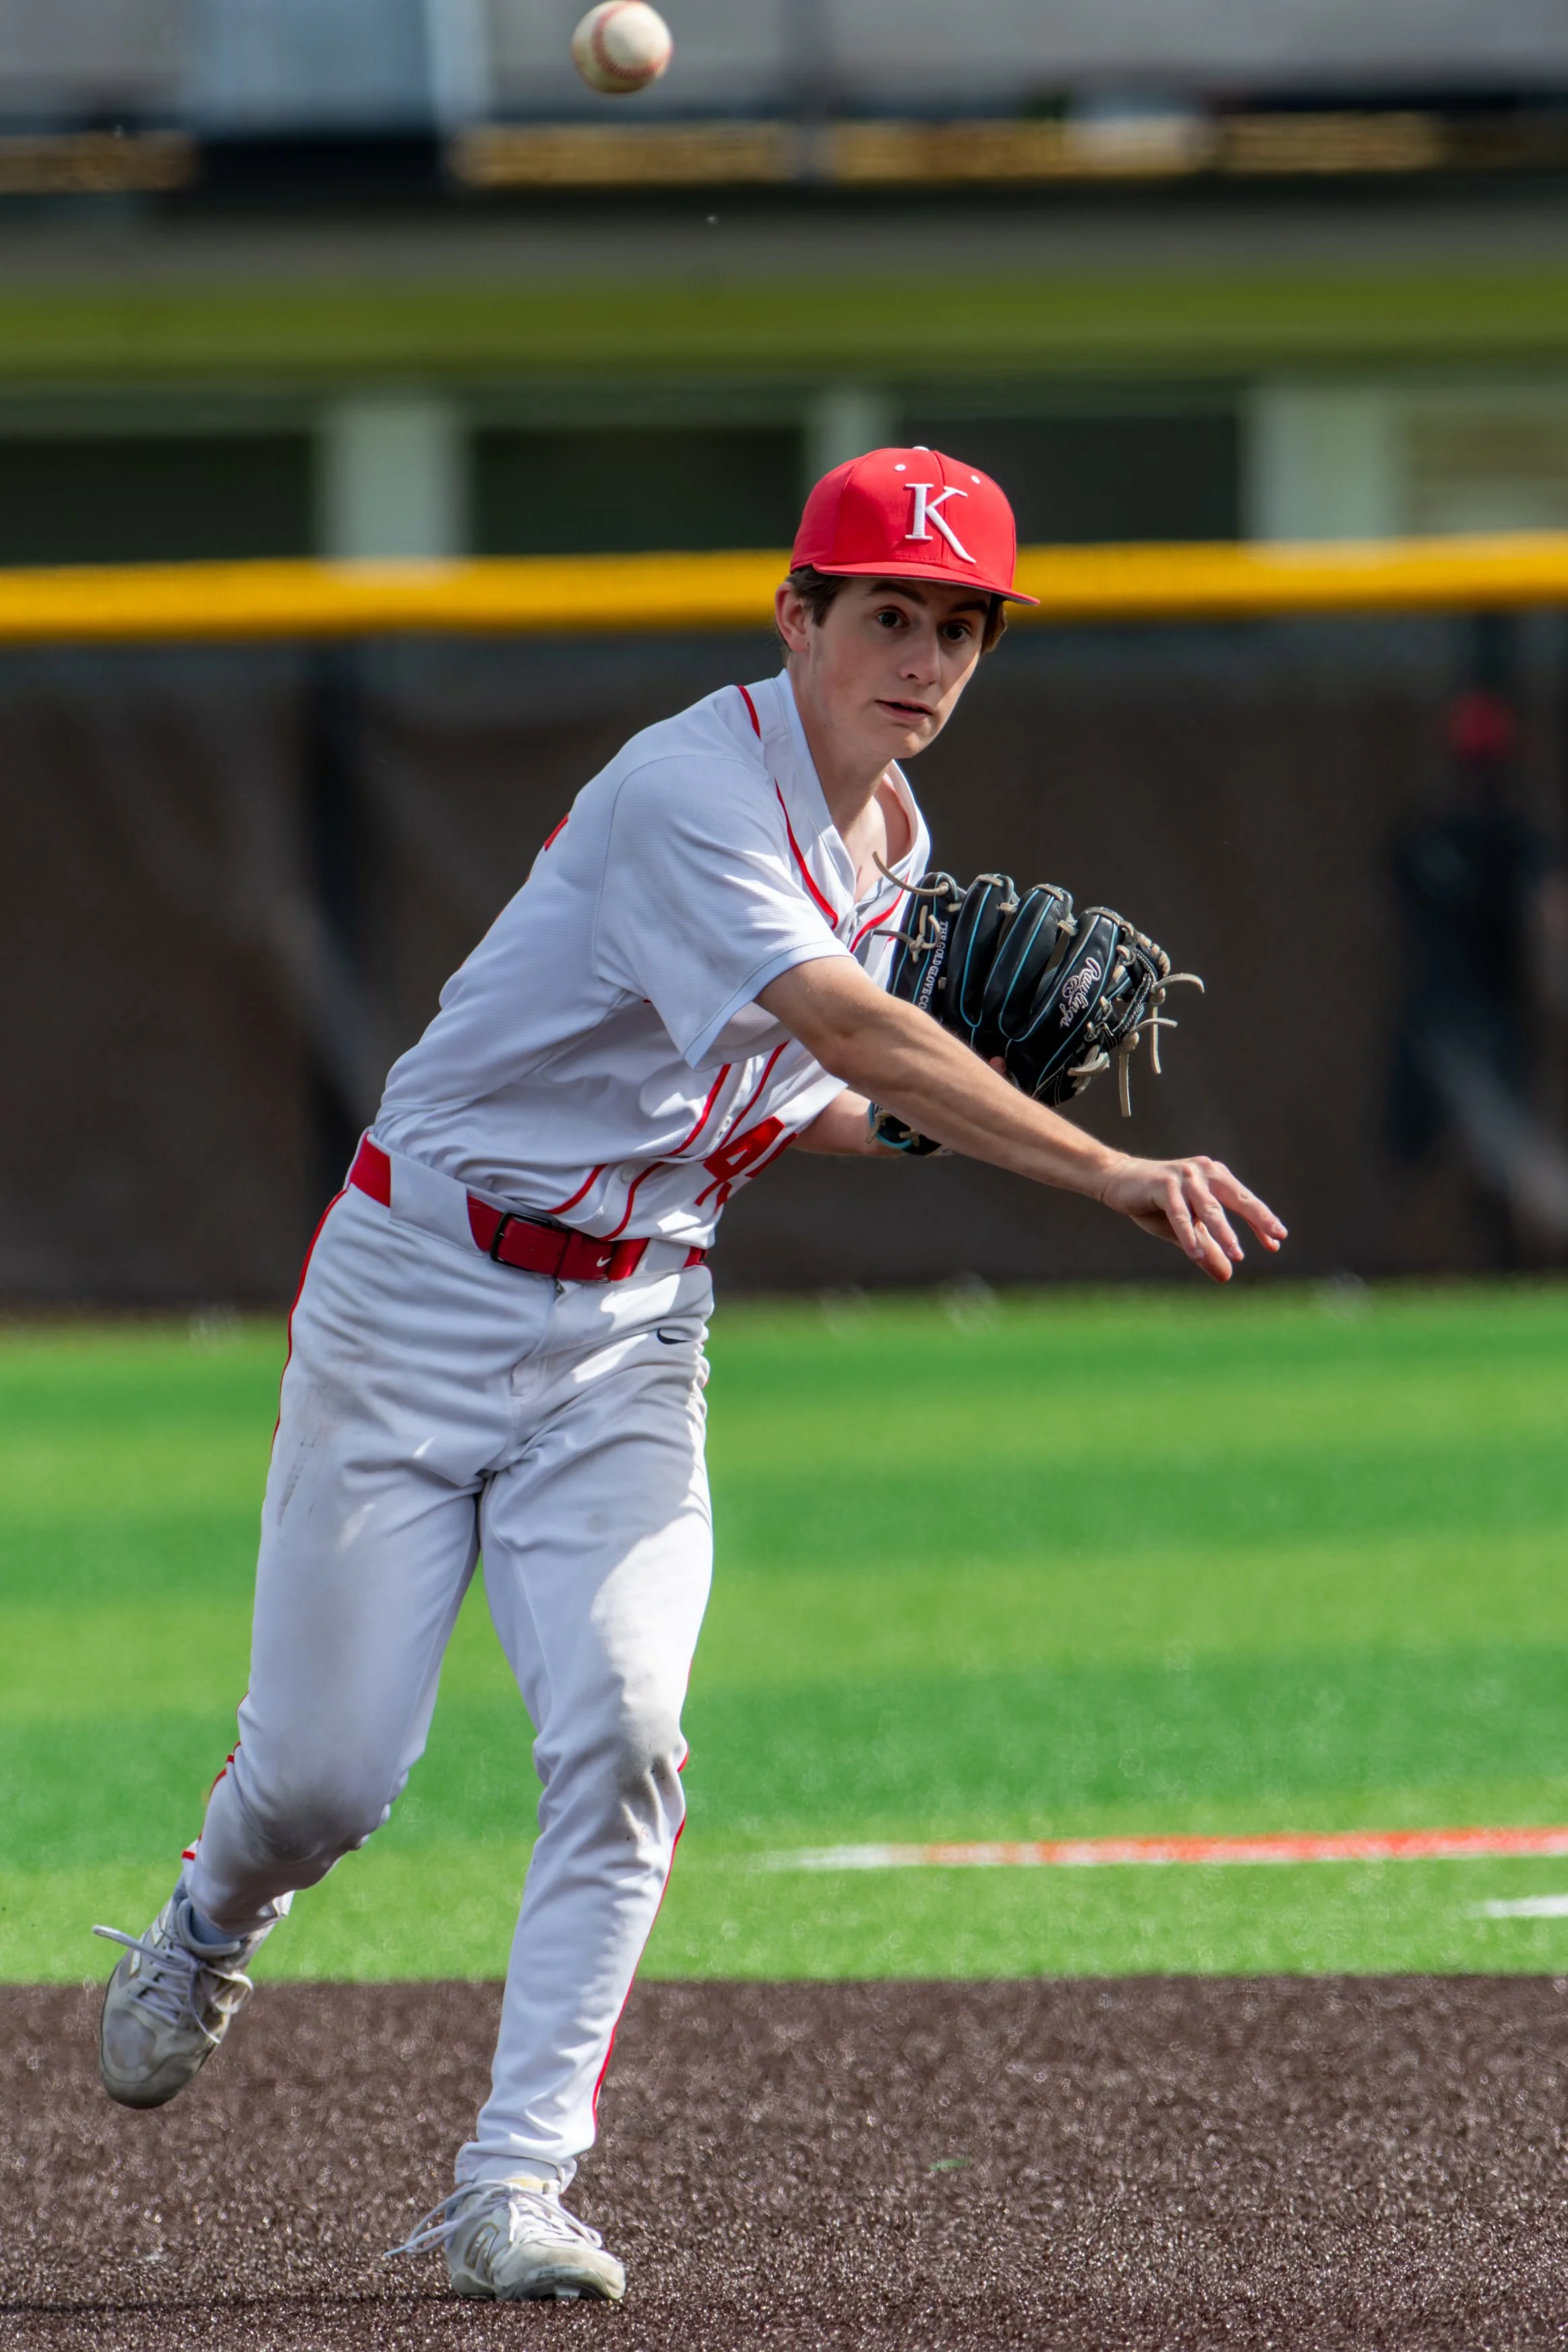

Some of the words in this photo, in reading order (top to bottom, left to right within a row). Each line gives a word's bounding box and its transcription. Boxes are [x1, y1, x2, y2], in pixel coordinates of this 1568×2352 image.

[905, 483, 976, 564] K
[940, 921, 948, 940] THE
[932, 942, 946, 965] GOLD
[922, 965, 938, 996] GLOVE
[1059, 957, 1102, 1028] Rawlings
